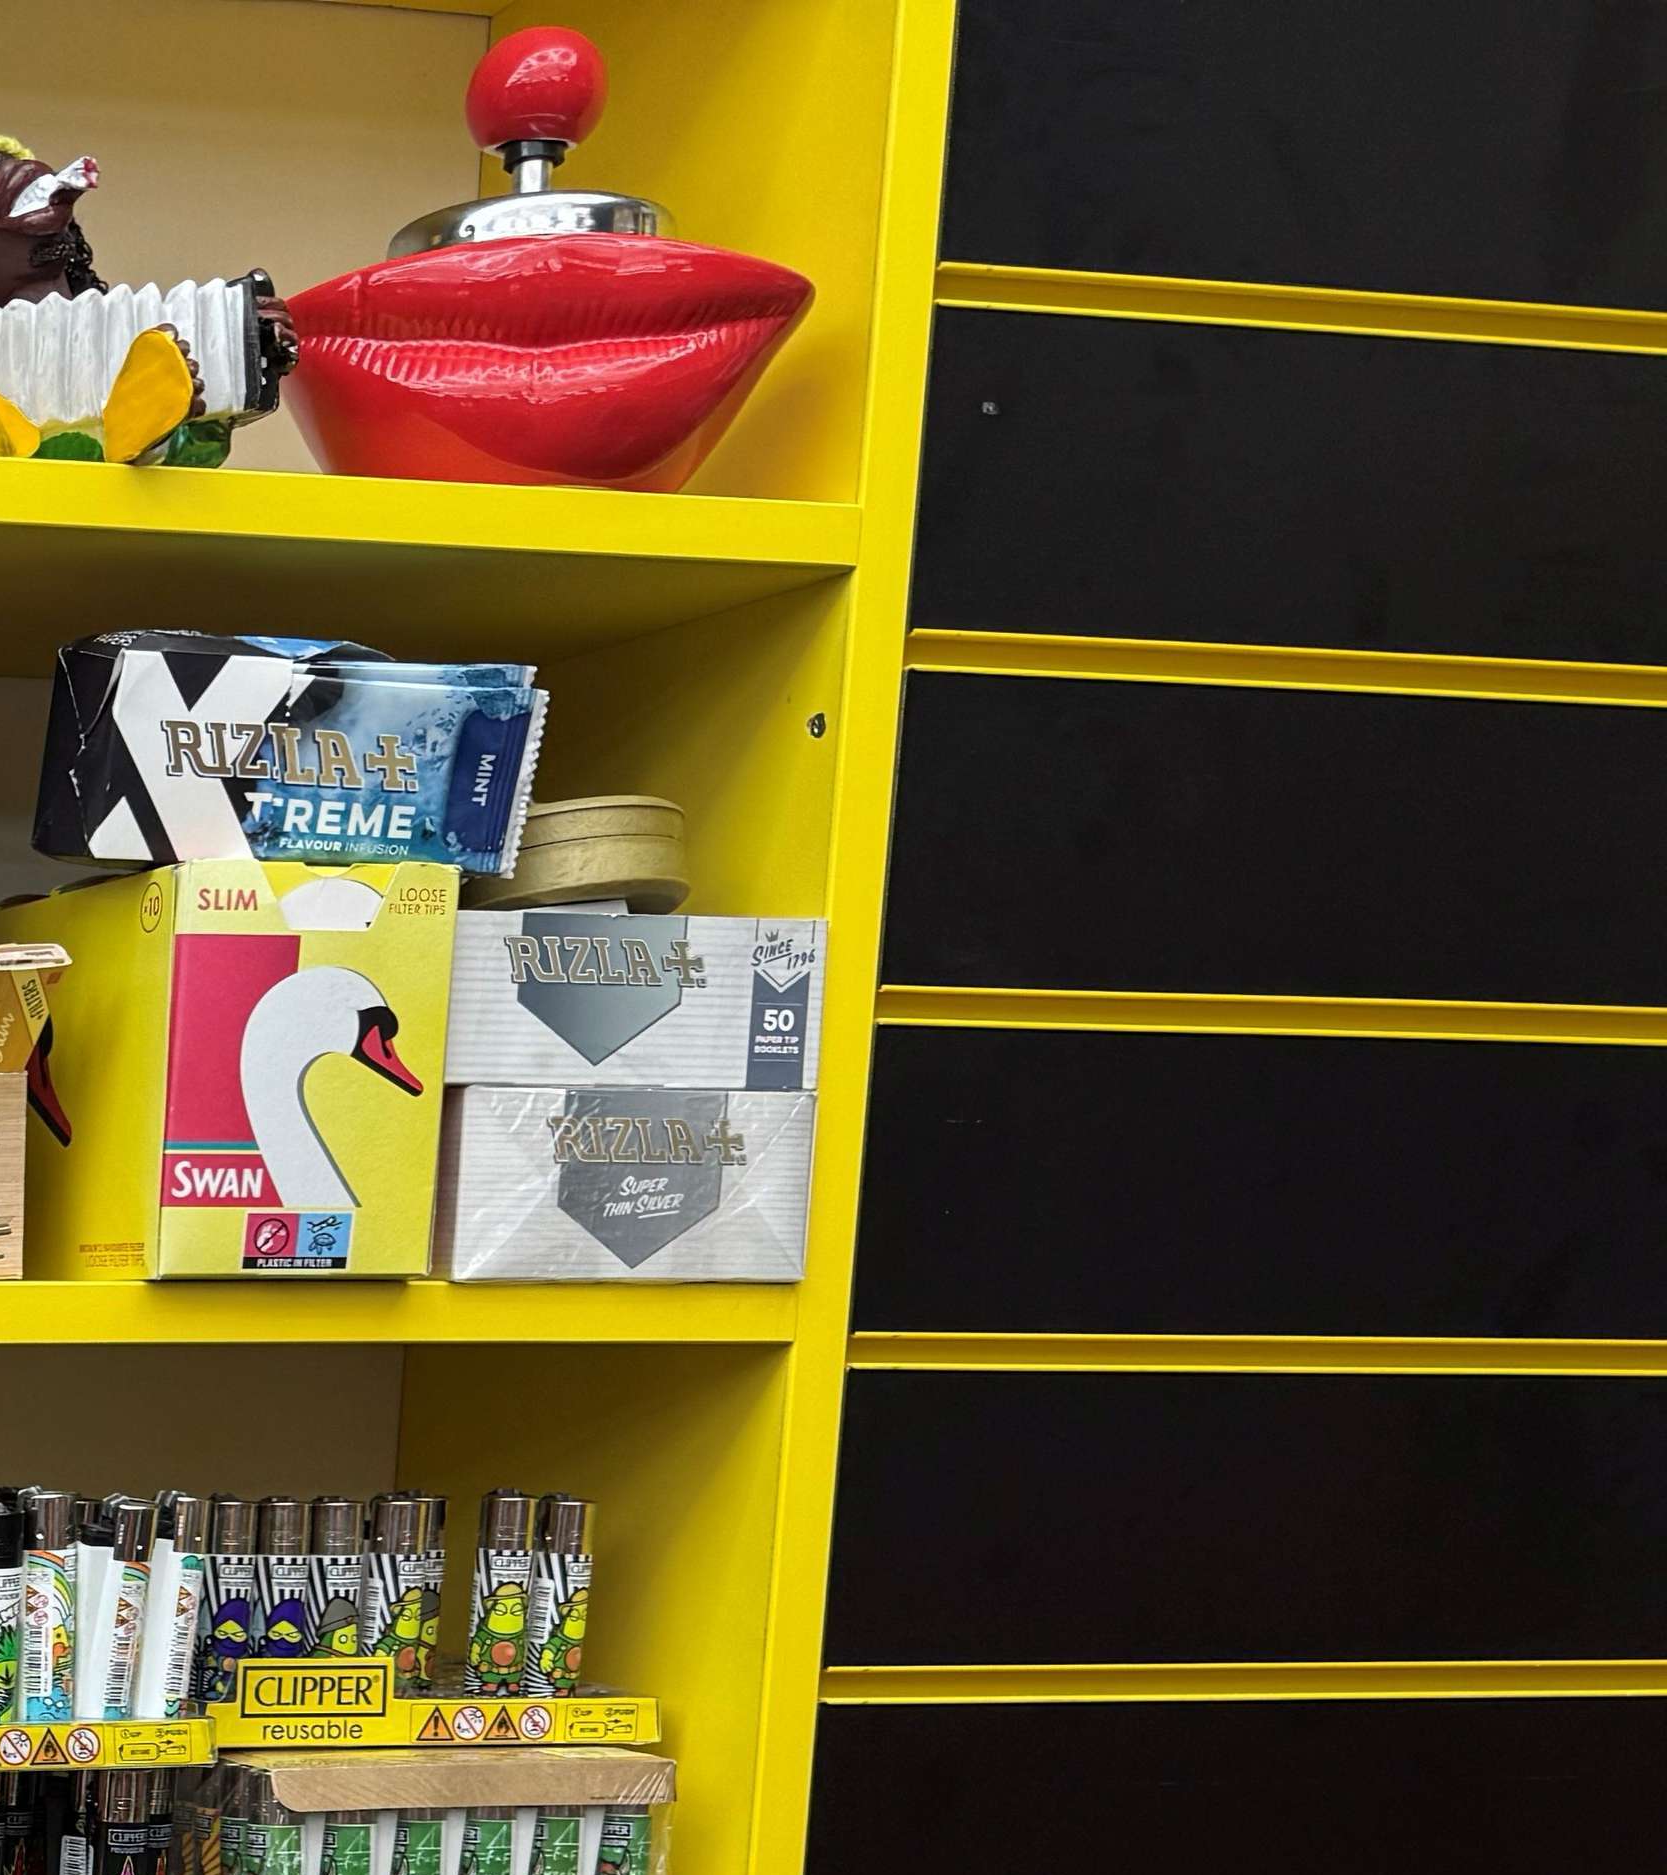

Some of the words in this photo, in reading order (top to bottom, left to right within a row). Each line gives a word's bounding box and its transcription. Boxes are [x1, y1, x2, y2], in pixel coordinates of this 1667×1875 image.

[472, 753, 496, 806] MINT
[279, 838, 342, 853] FLAVOUR
[197, 888, 260, 911] SLIM
[398, 886, 447, 904] LOOSE
[388, 902, 418, 916] FILTER
[423, 903, 447, 917] TIPS
[787, 948, 817, 970] 1796
[761, 1008, 795, 1033] 50
[603, 1199, 635, 1218] THIN
[638, 1192, 682, 1214] SILVER
[254, 1678, 373, 1708] CLIPPER
[262, 1721, 364, 1742] reusable
